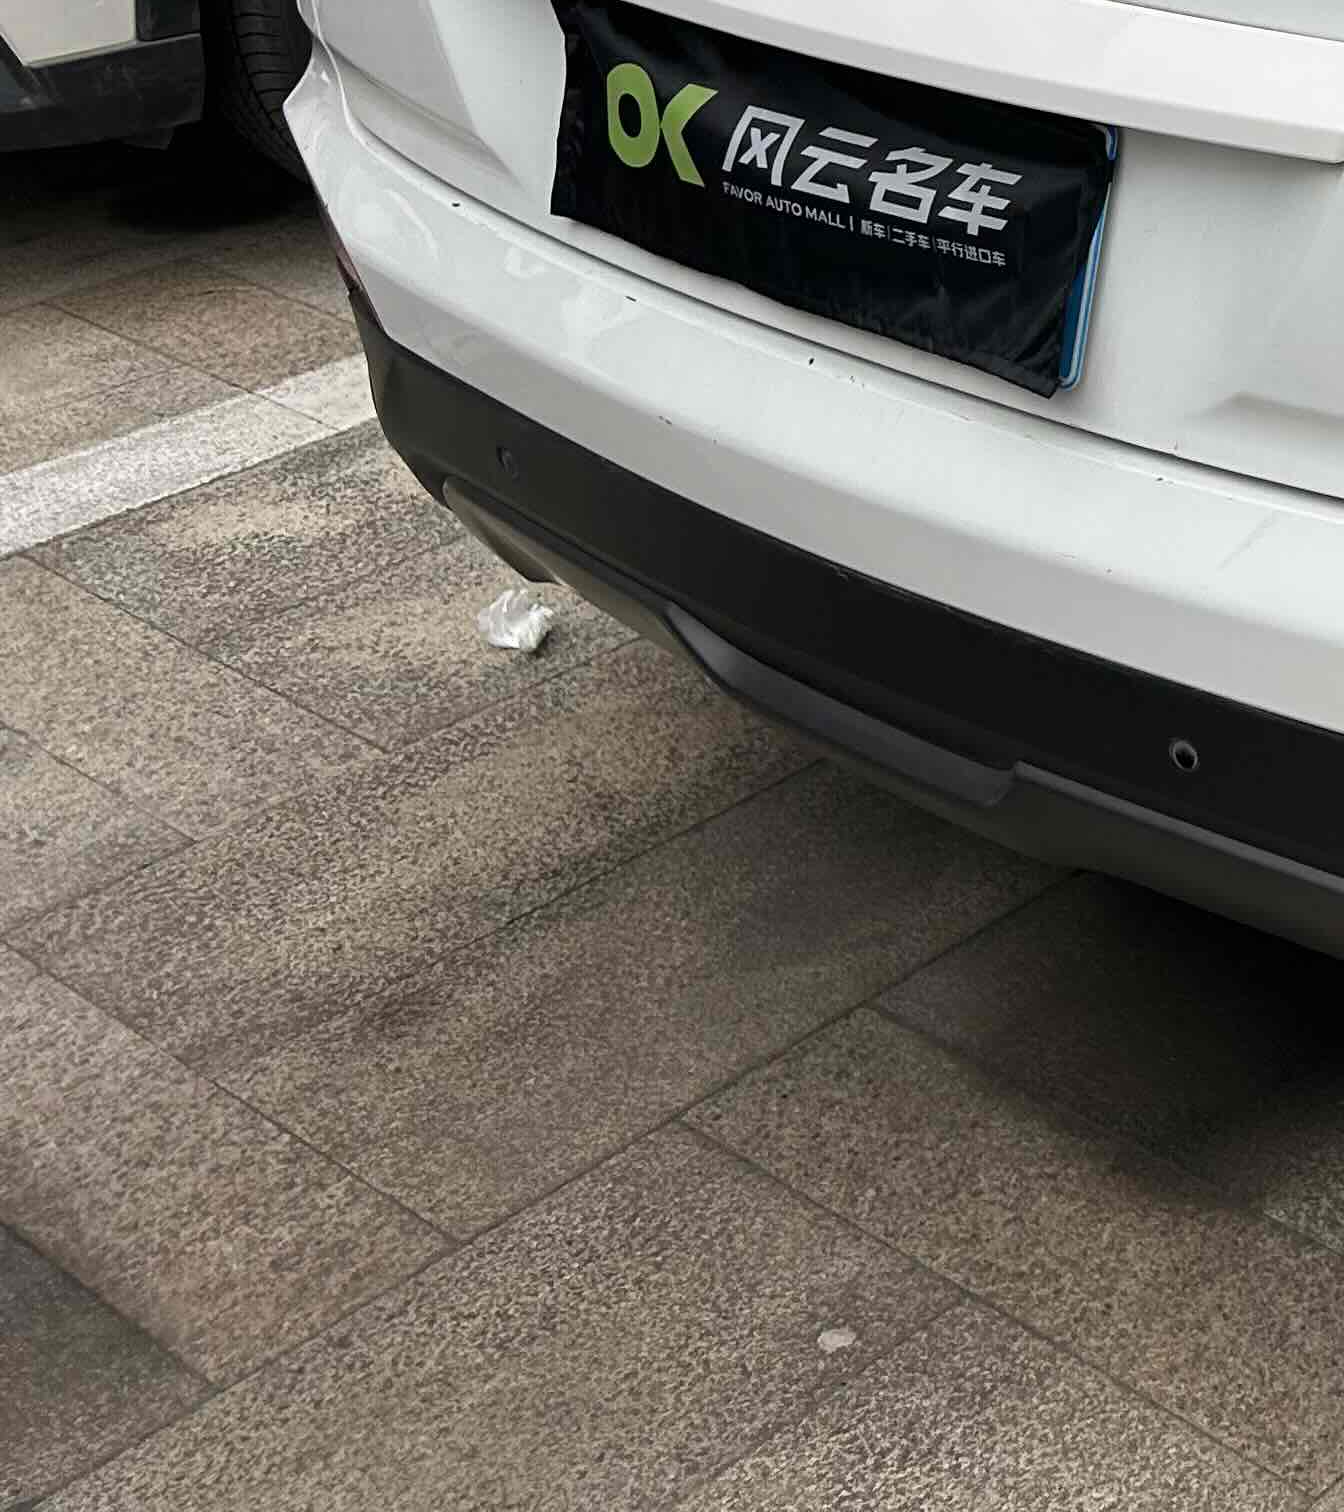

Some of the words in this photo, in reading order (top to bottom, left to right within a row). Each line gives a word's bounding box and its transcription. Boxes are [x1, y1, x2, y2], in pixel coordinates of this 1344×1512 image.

[721, 104, 1024, 236] 风云名车
[722, 181, 763, 207] FAVOR
[766, 196, 803, 217] AUTO
[805, 206, 846, 230] MALL
